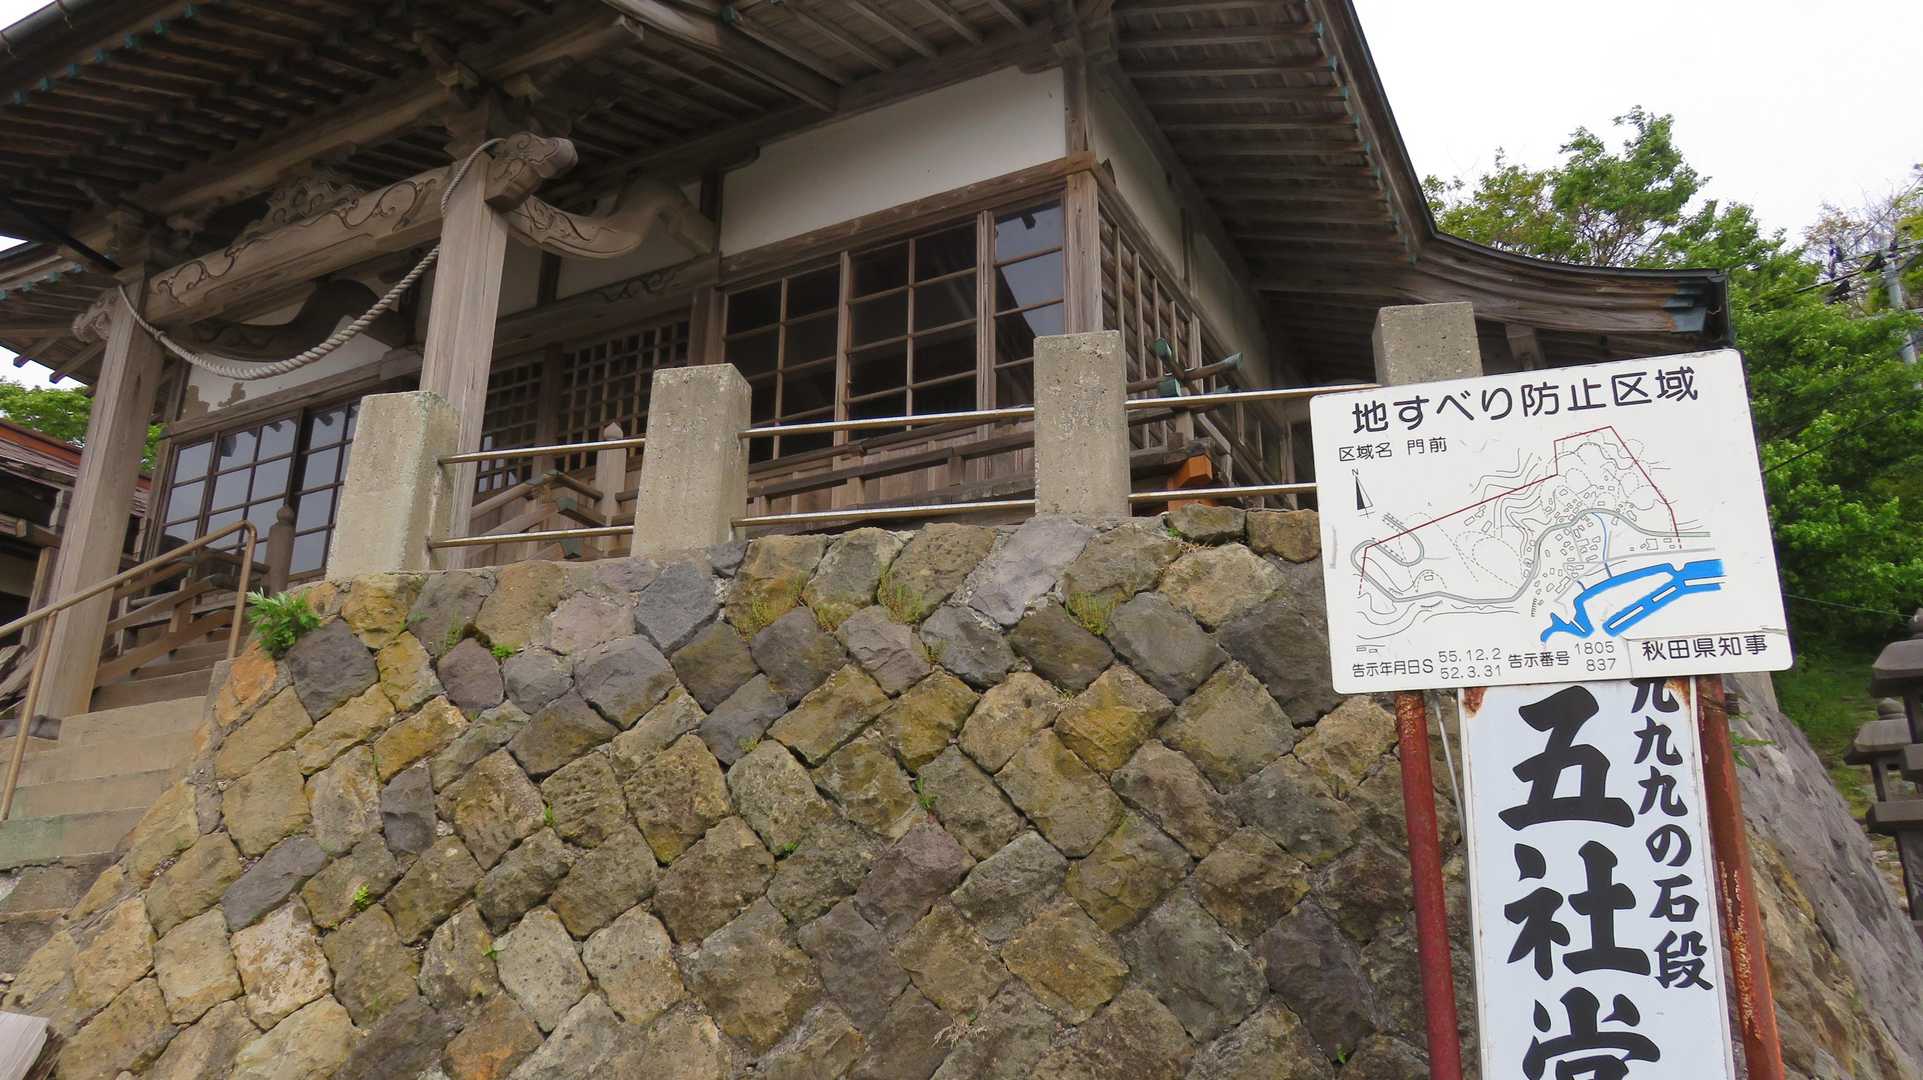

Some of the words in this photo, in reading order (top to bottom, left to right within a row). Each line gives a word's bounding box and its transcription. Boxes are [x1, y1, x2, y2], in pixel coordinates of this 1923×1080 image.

[1352, 365, 1698, 434] 地すべり防止区域
[1339, 442, 1392, 461] 区域名
[1407, 436, 1447, 455] 門前
[1438, 648, 1502, 663] 55.12.2
[1508, 650, 1570, 669] 告示番号
[1574, 641, 1615, 656] 1805
[1642, 634, 1768, 662] 秋田県知事
[1440, 664, 1502, 680] 52.3.31
[1586, 658, 1616, 673] 837
[1631, 679, 1714, 990] 九九九の石段
